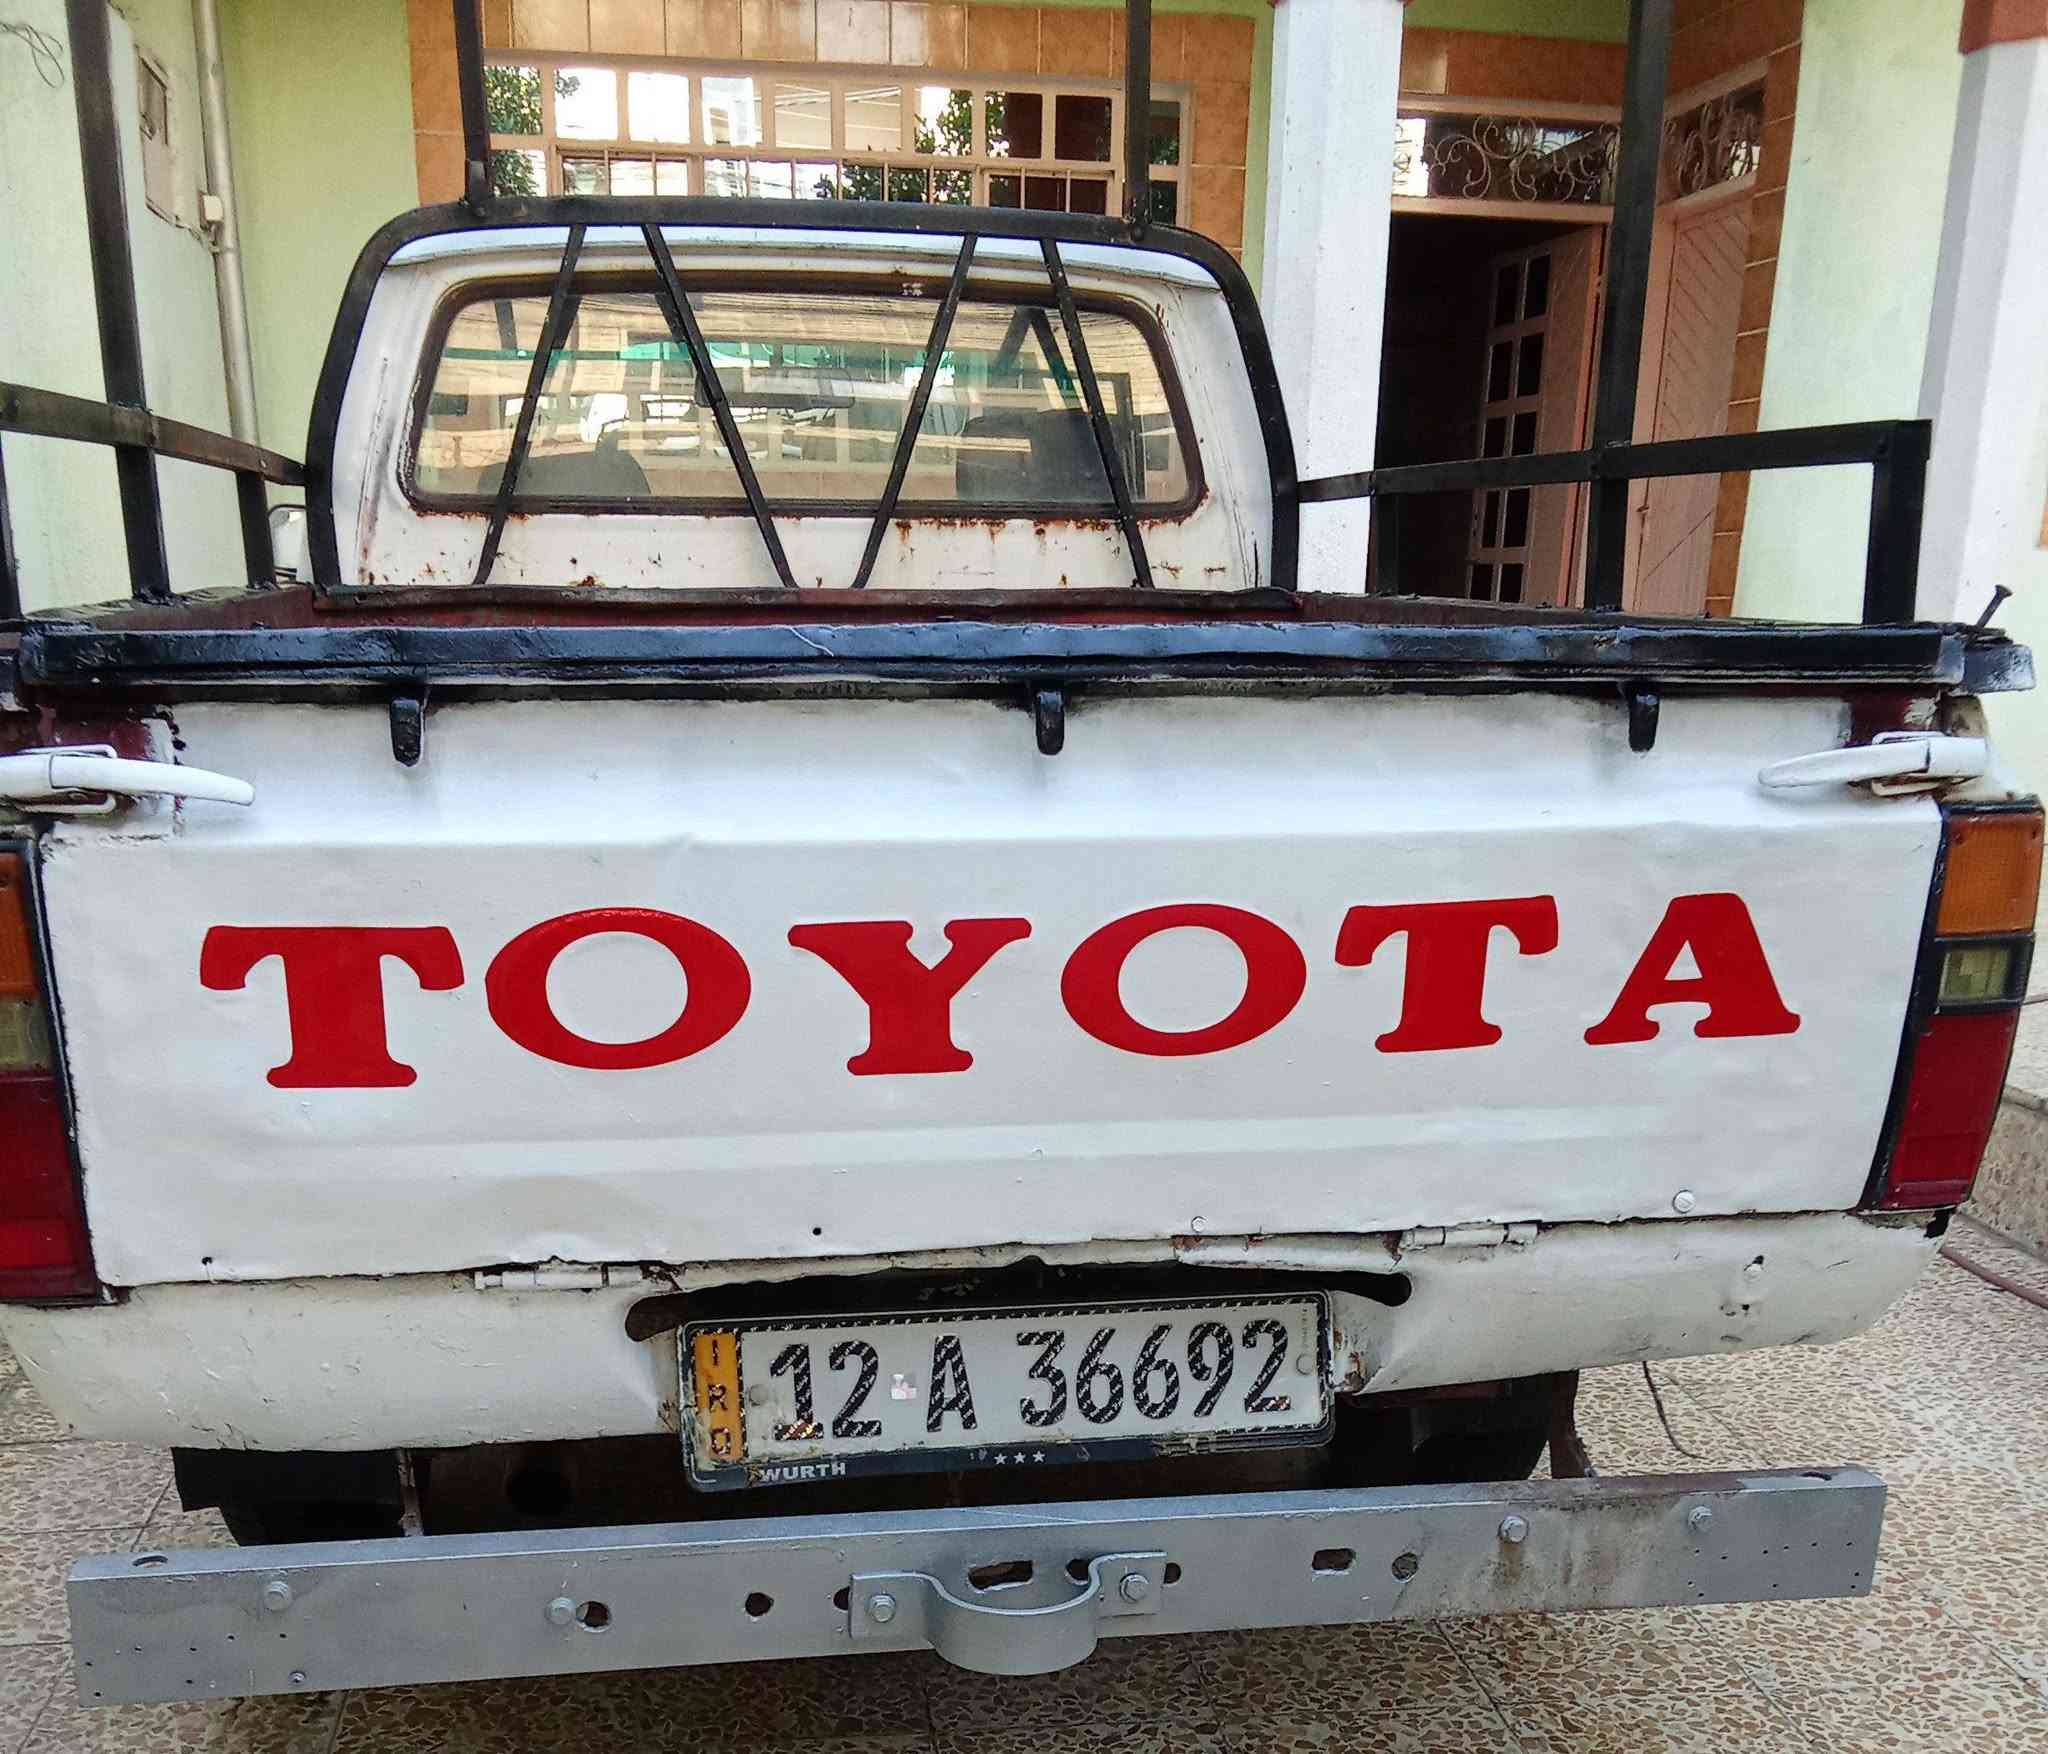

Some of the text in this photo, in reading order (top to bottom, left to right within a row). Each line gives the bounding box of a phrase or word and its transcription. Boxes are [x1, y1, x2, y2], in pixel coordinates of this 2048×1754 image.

[200, 893, 1801, 1089] TOYOTA
[769, 1340, 882, 1440] 12
[926, 1335, 978, 1434] A
[1016, 1318, 1290, 1428] 36692
[758, 1461, 847, 1482] WURTH
